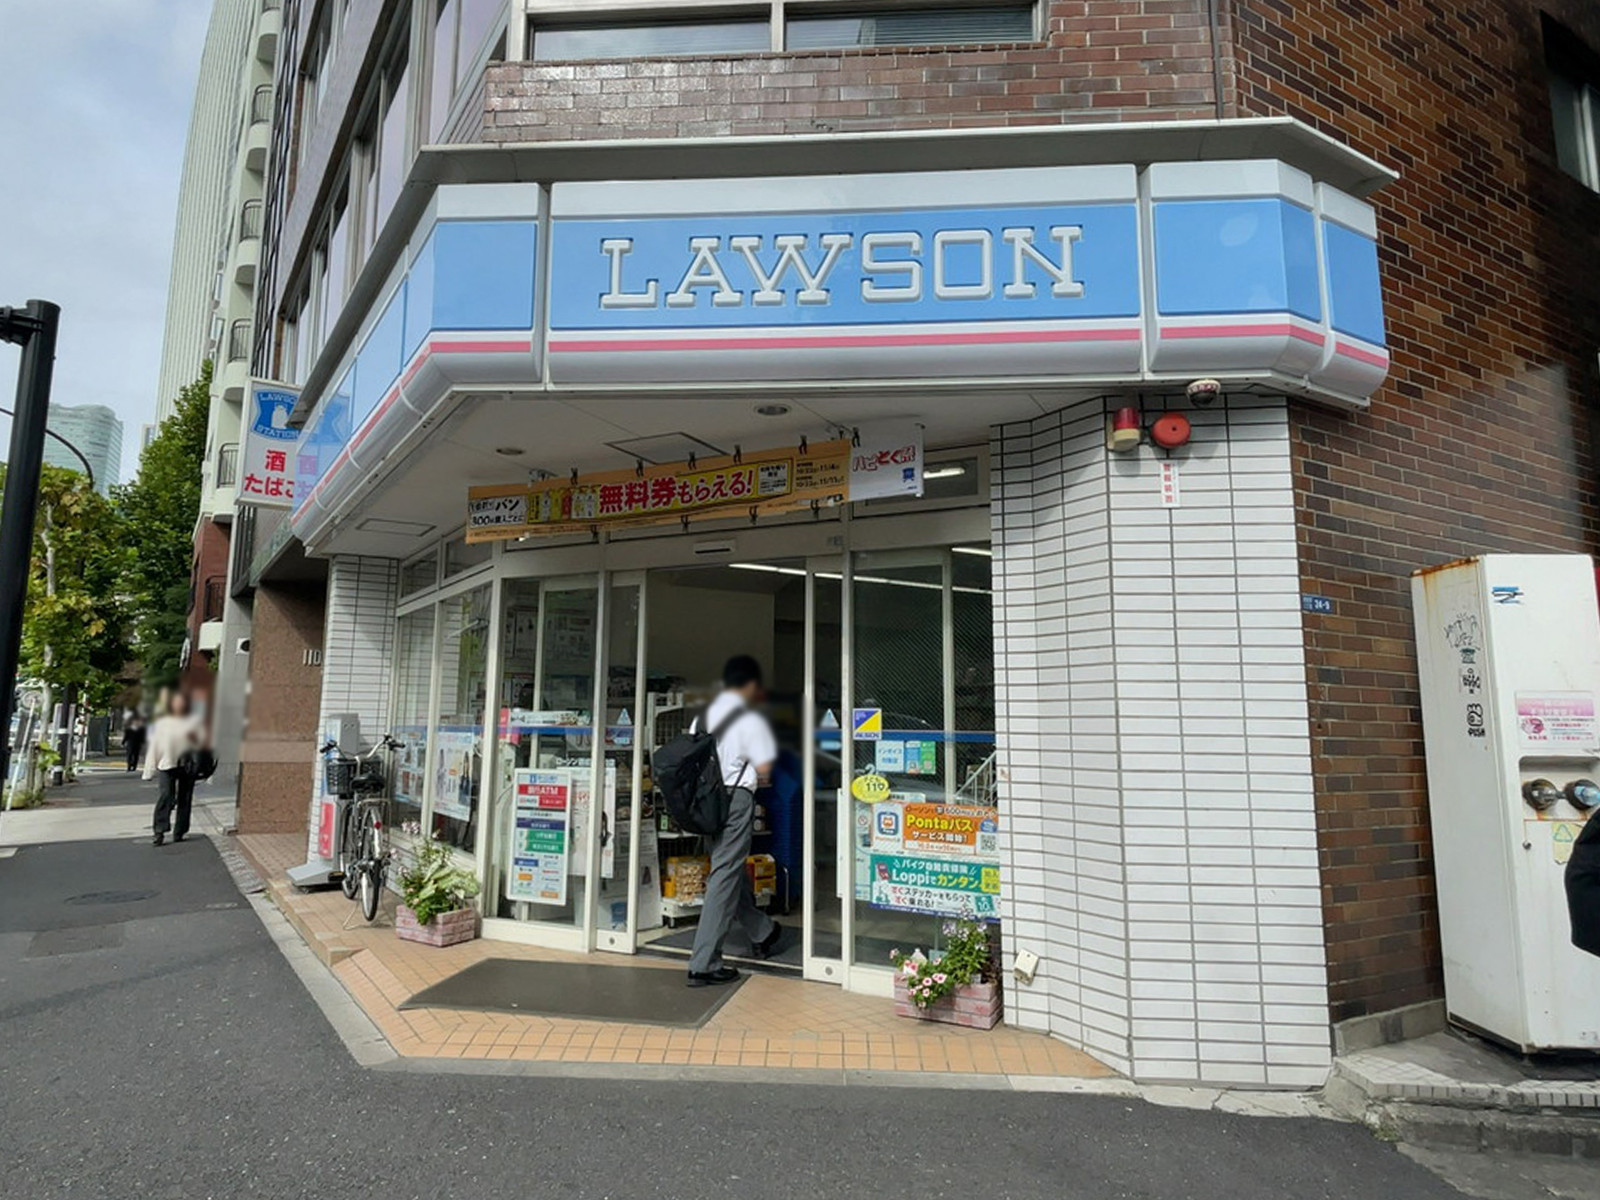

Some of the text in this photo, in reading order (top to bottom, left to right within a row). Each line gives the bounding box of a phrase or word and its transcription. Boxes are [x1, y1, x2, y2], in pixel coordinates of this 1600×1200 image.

[599, 225, 1085, 308] LAWSON
[265, 449, 286, 472] 酒
[600, 470, 753, 513] 無料券もらえる!
[906, 813, 973, 832] Pontaパス
